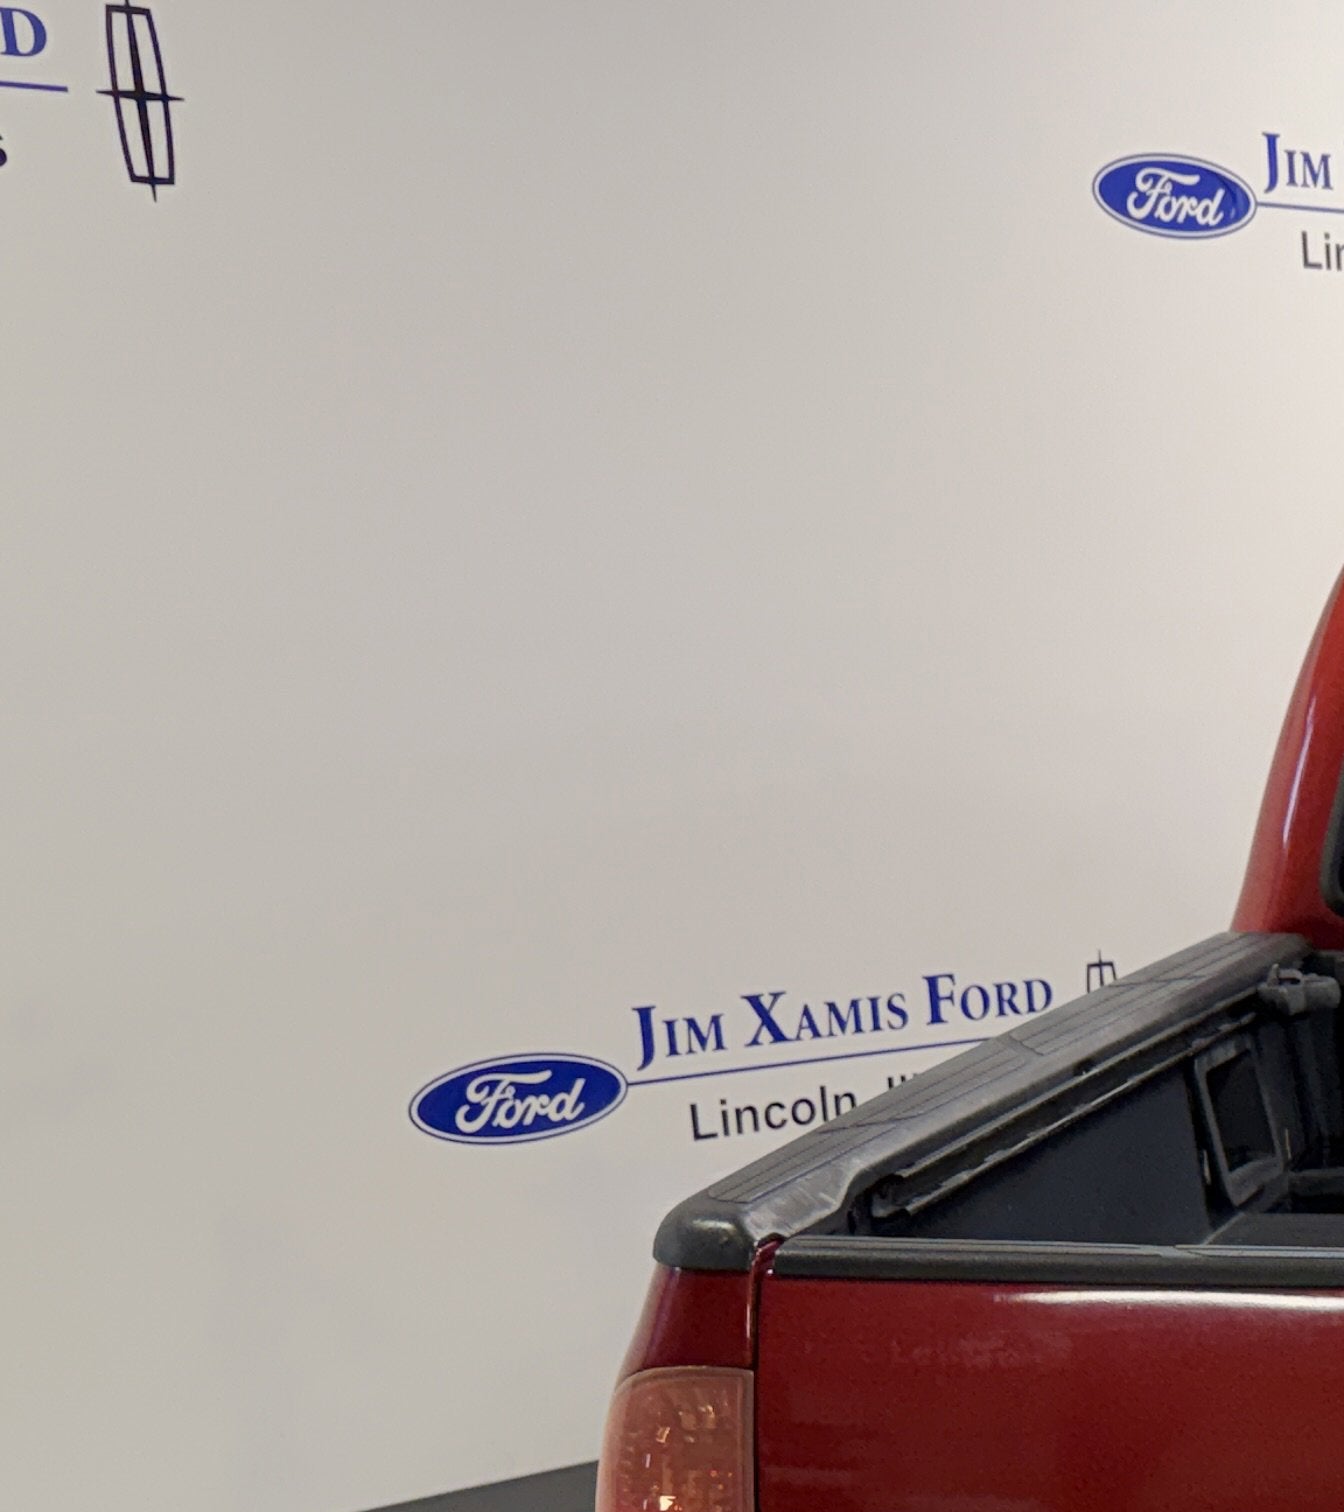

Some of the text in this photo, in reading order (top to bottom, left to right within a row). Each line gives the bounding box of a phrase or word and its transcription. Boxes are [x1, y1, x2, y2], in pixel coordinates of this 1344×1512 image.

[1262, 131, 1334, 193] JIM
[1127, 166, 1224, 227] Ford
[631, 973, 1053, 1071] JIM XAMIS FORD
[455, 1069, 585, 1130] Ford
